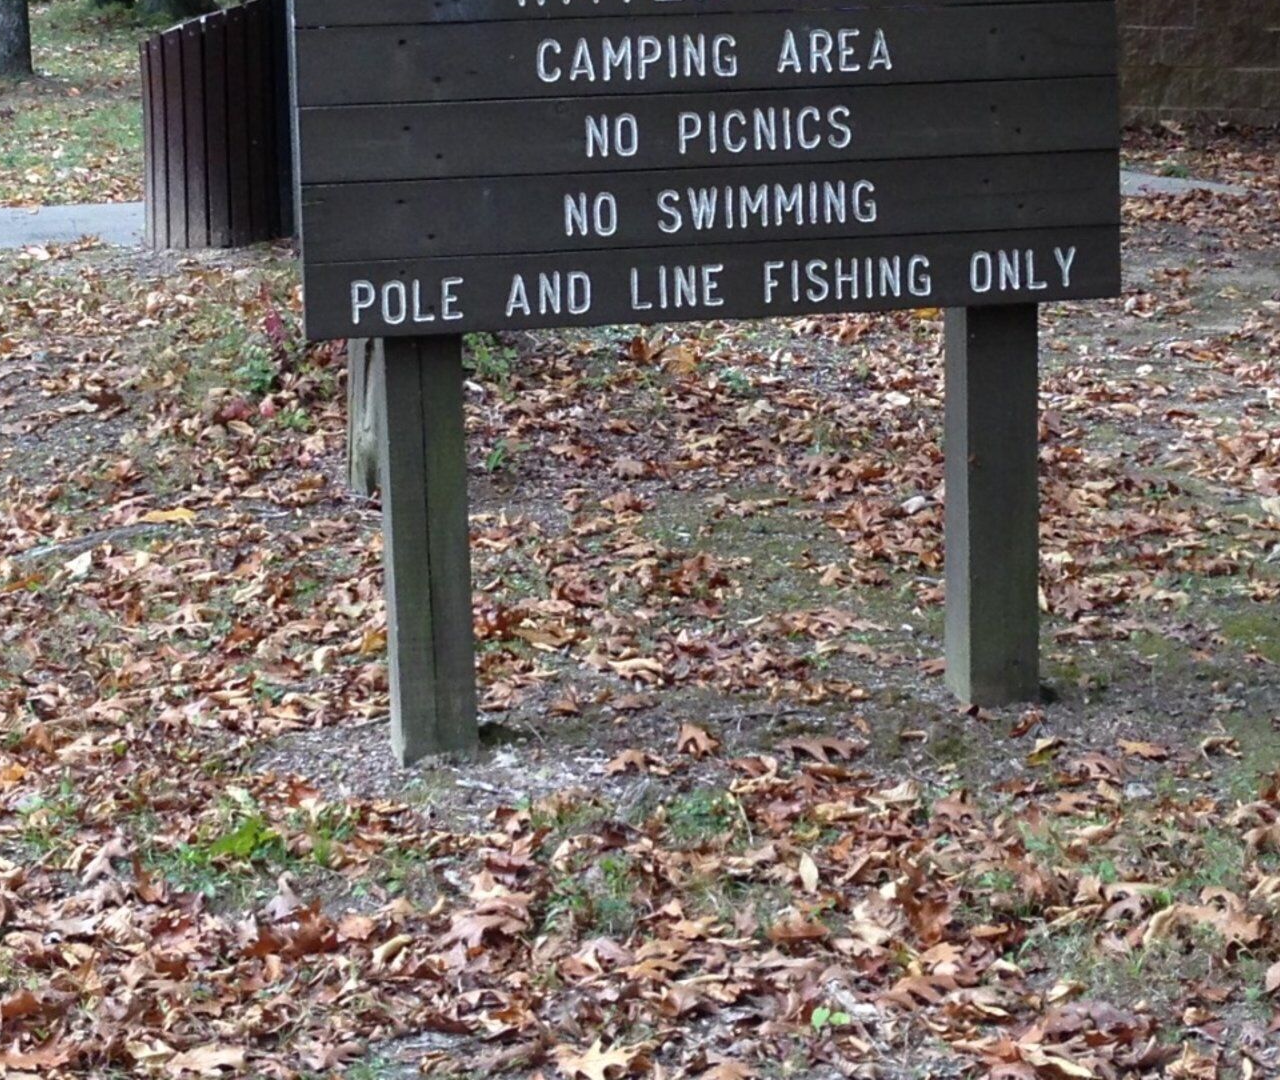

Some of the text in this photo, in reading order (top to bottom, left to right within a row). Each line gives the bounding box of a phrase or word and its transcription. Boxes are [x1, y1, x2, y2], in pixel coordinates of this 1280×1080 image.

[536, 28, 893, 83] CAMPING AREA
[585, 105, 852, 158] NO PICNICS
[564, 179, 877, 237] NO SWIMMING
[350, 246, 1076, 325] POLE AND LINE FISHING ONLY
